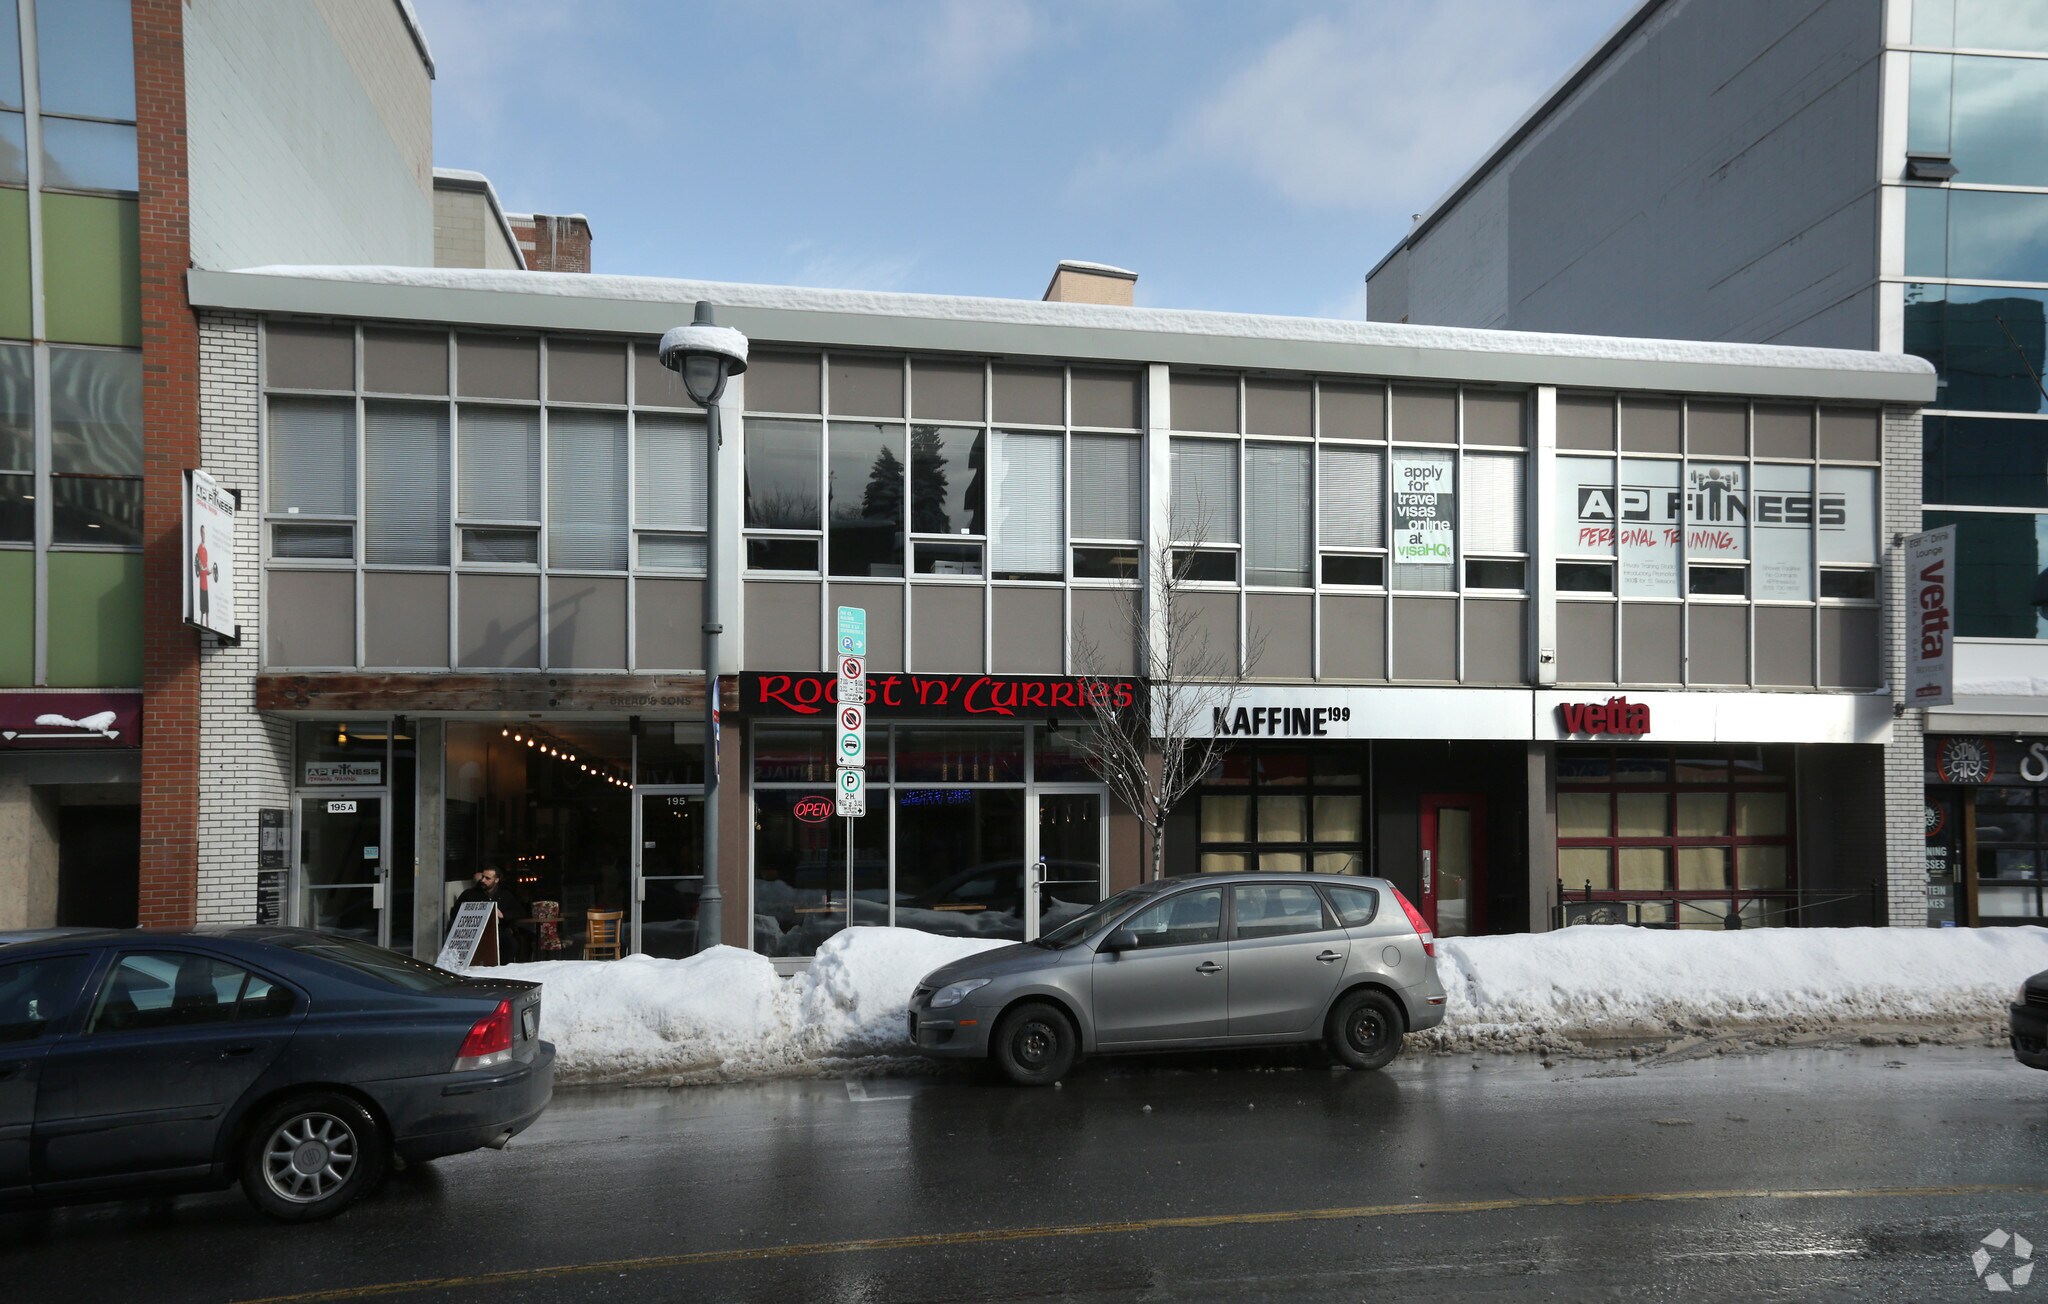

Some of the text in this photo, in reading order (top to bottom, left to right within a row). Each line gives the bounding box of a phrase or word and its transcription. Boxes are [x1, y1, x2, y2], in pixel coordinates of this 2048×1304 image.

[1404, 465, 1443, 480] apply
[1408, 480, 1429, 491] for
[1397, 492, 1437, 505] travel
[1579, 489, 1649, 519] AP
[1397, 506, 1436, 519] visas
[1408, 517, 1450, 532] online
[1409, 533, 1422, 544] at
[1916, 546, 1943, 558] Lounge
[1920, 559, 1949, 660] vetta
[610, 696, 691, 705] BREAD & SONS
[1213, 707, 1328, 735] KAFFINE
[1560, 695, 1650, 735] vetta
[307, 768, 328, 776] AP
[667, 798, 686, 806] 195
[796, 803, 831, 817] OPEN
[1926, 846, 1947, 857] NING
[1925, 860, 1946, 870] SSES
[1927, 886, 1946, 896] TEIN
[1926, 899, 1945, 909] AKES
[457, 915, 483, 928] ESPRESSO
